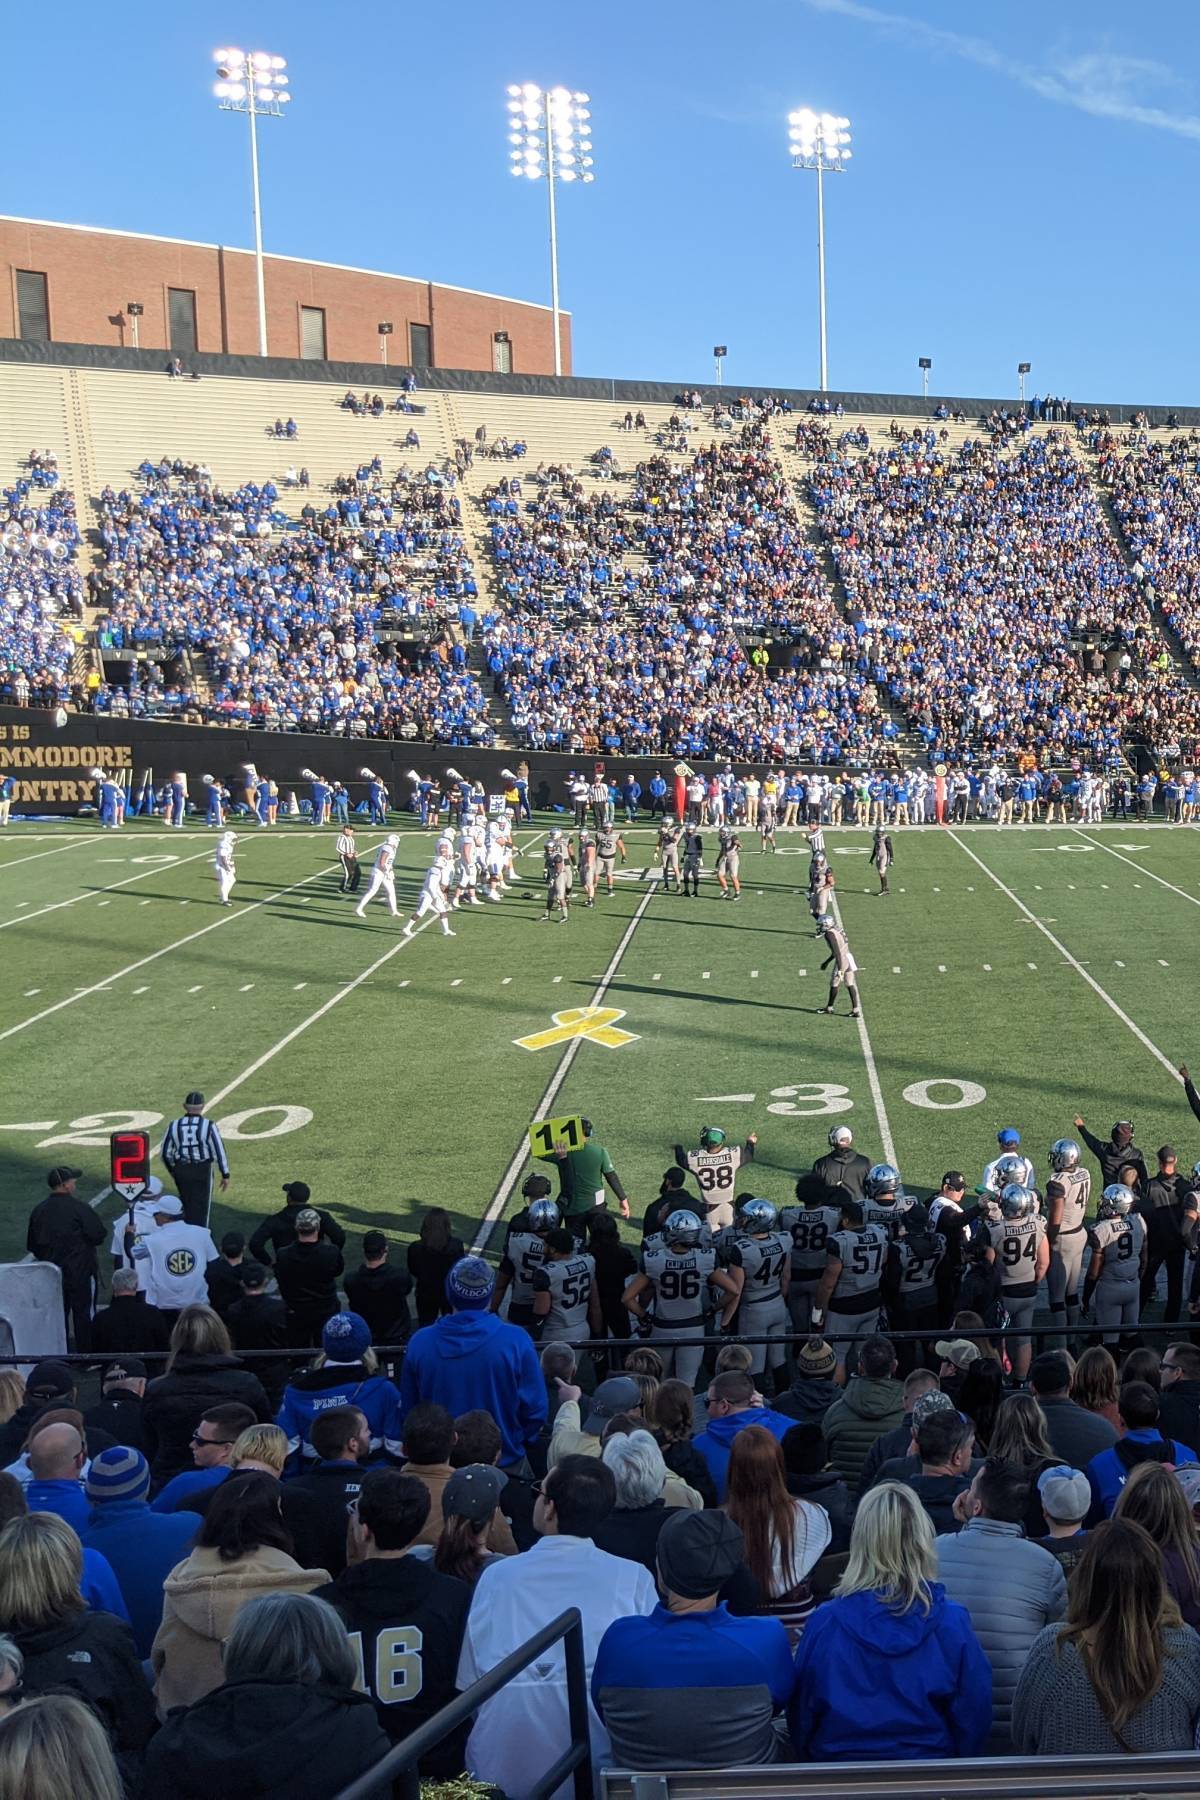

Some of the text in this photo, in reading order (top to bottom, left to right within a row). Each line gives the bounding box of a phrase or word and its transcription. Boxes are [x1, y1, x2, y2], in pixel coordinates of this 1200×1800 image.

[12, 725, 30, 740] IS
[182, 1125, 200, 1146] H
[535, 1119, 578, 1151] 11
[113, 1135, 146, 1184] 2
[698, 1166, 733, 1191] 38
[1075, 1180, 1090, 1208] 41
[791, 1222, 829, 1250] 88
[1002, 1233, 1037, 1267] 94
[1117, 1232, 1133, 1261] 9
[167, 1251, 195, 1274] SEC
[753, 1252, 787, 1286] 44
[852, 1243, 882, 1275] 57
[905, 1252, 943, 1283] 27
[560, 1272, 592, 1310] 52
[659, 1271, 701, 1300] 96
[313, 1395, 348, 1410] PINK
